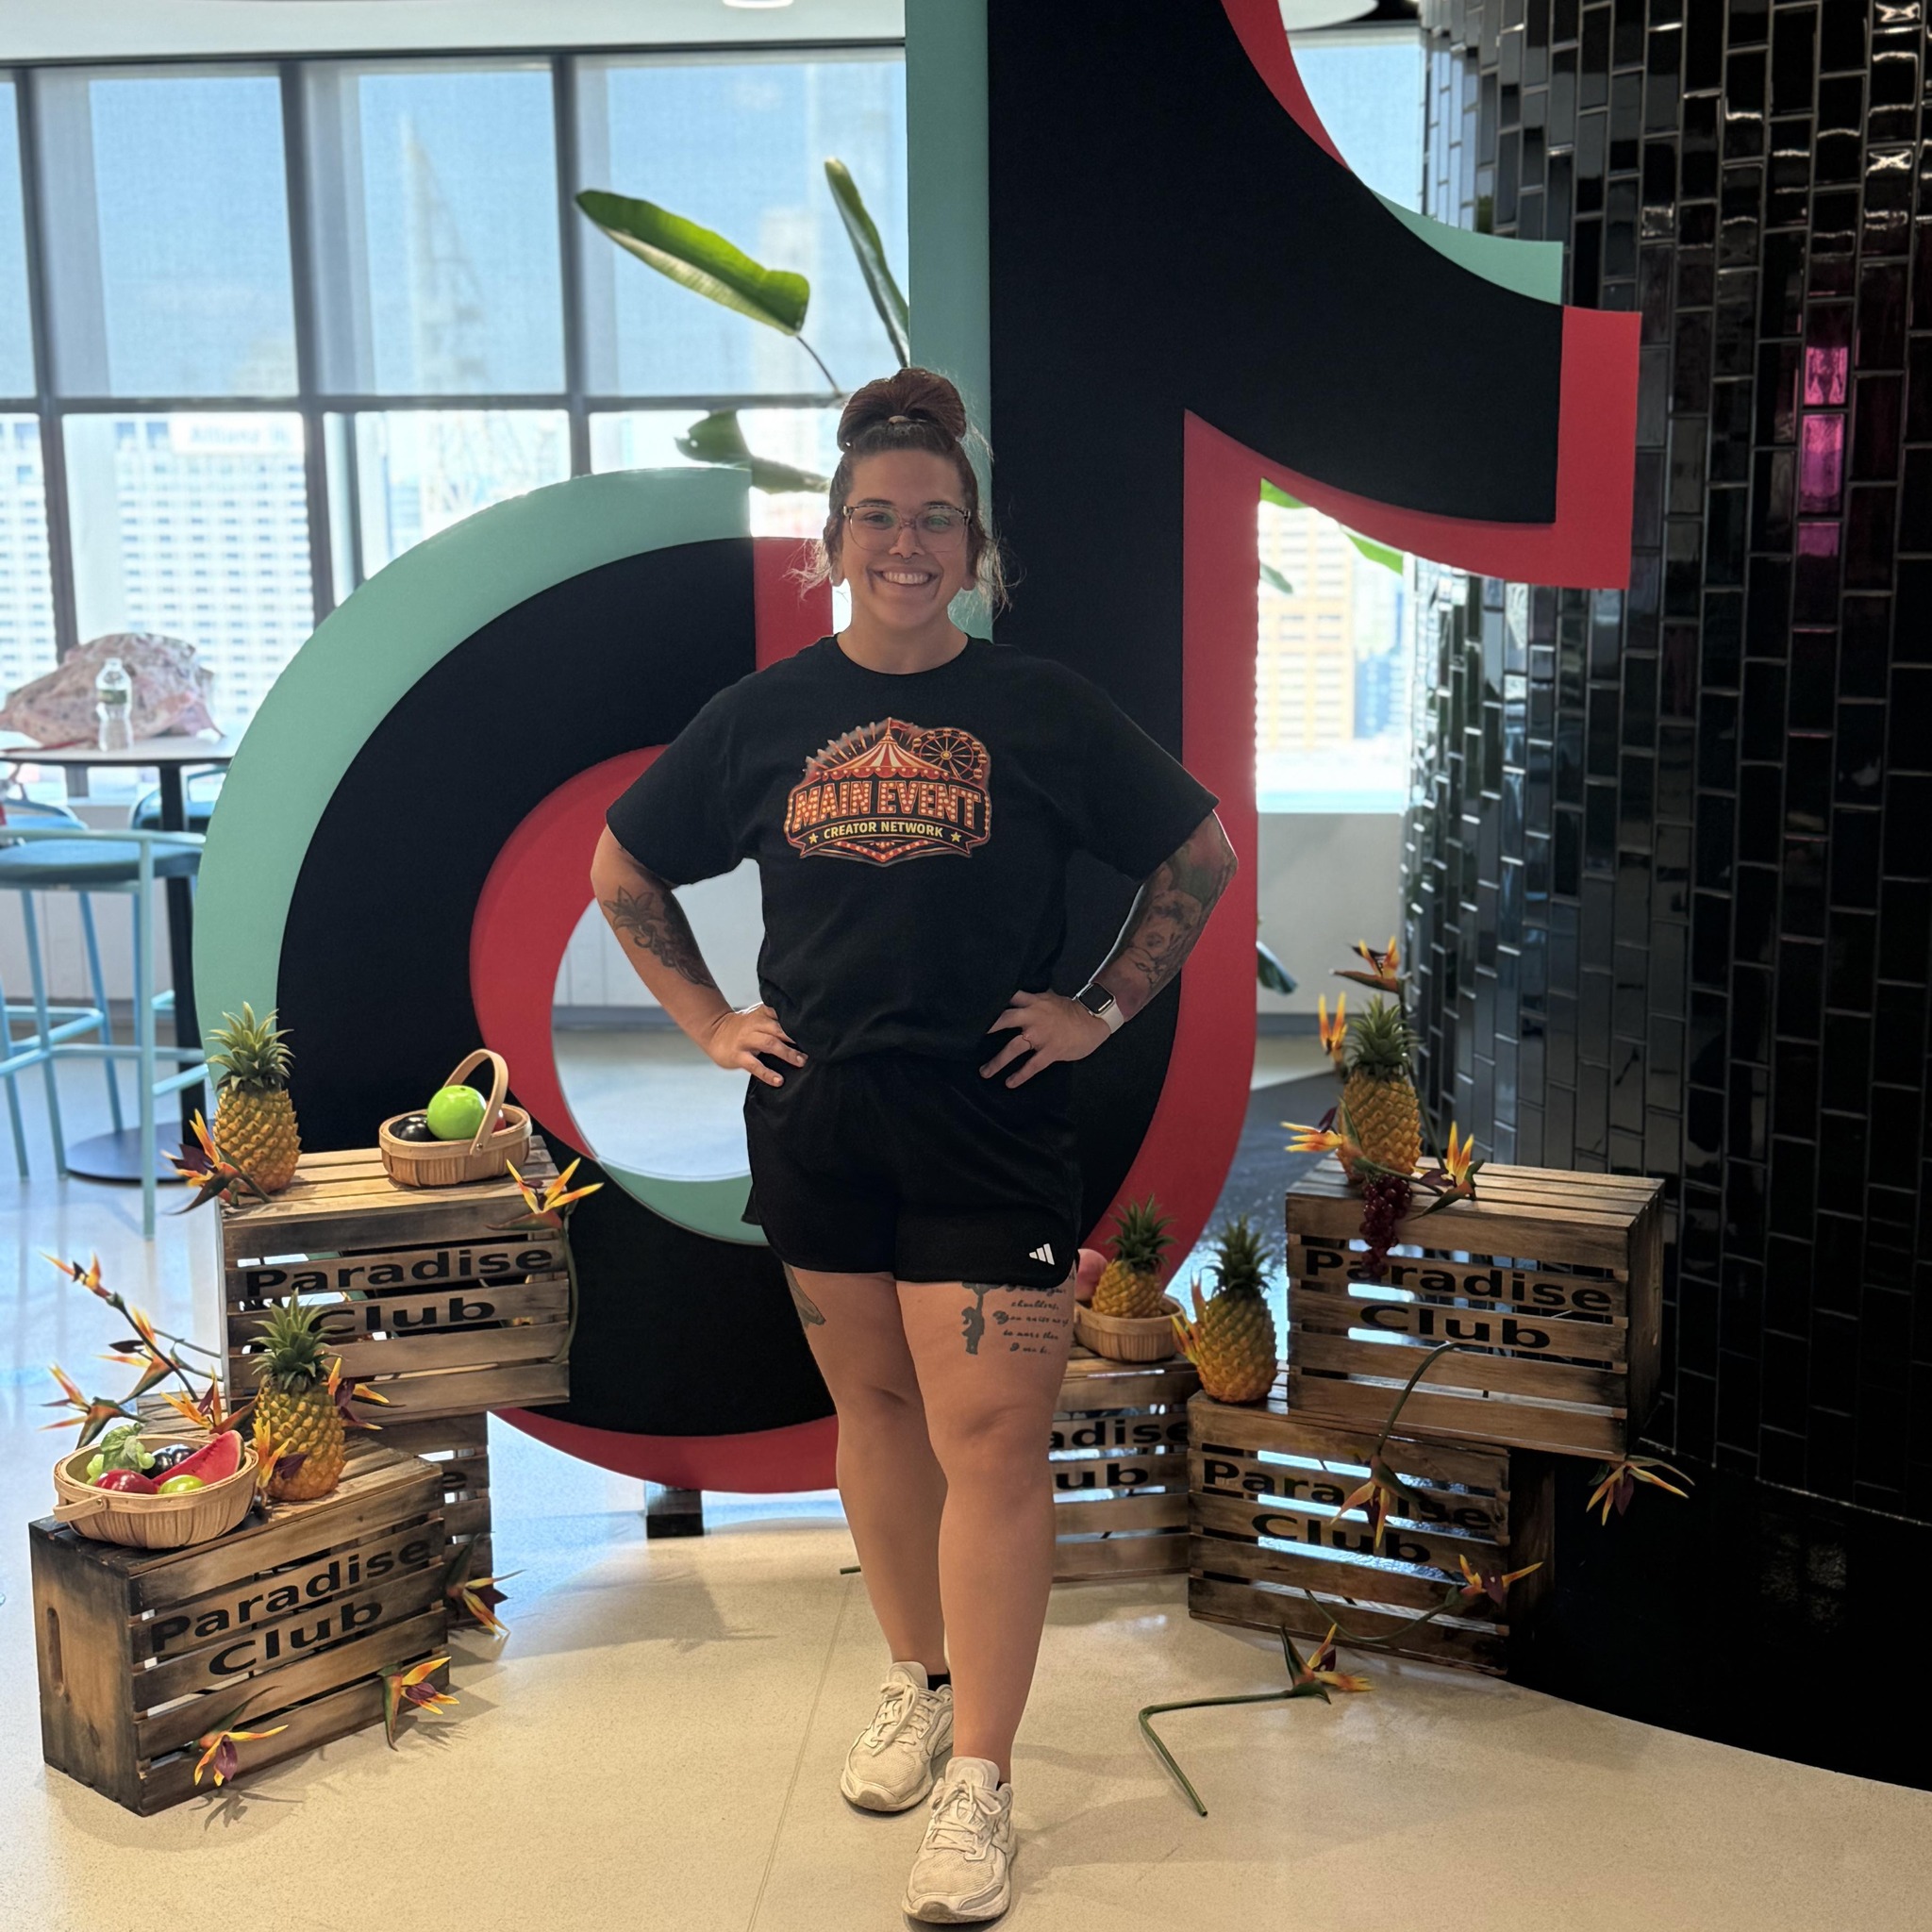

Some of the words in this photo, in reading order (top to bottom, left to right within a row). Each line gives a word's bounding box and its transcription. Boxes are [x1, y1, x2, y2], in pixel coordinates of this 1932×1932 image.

[792, 781, 872, 832] MAIN
[877, 781, 981, 830] EVENT
[824, 821, 877, 840] CREATOR
[880, 821, 943, 838] NETWORK
[245, 1248, 554, 1297] Paradise
[1306, 1248, 1612, 1312] Paradise
[308, 1297, 496, 1335] Club
[1359, 1305, 1552, 1350] Club
[1251, 1512, 1431, 1563] Club
[151, 1537, 431, 1654] Paradise
[208, 1602, 383, 1676] Club
